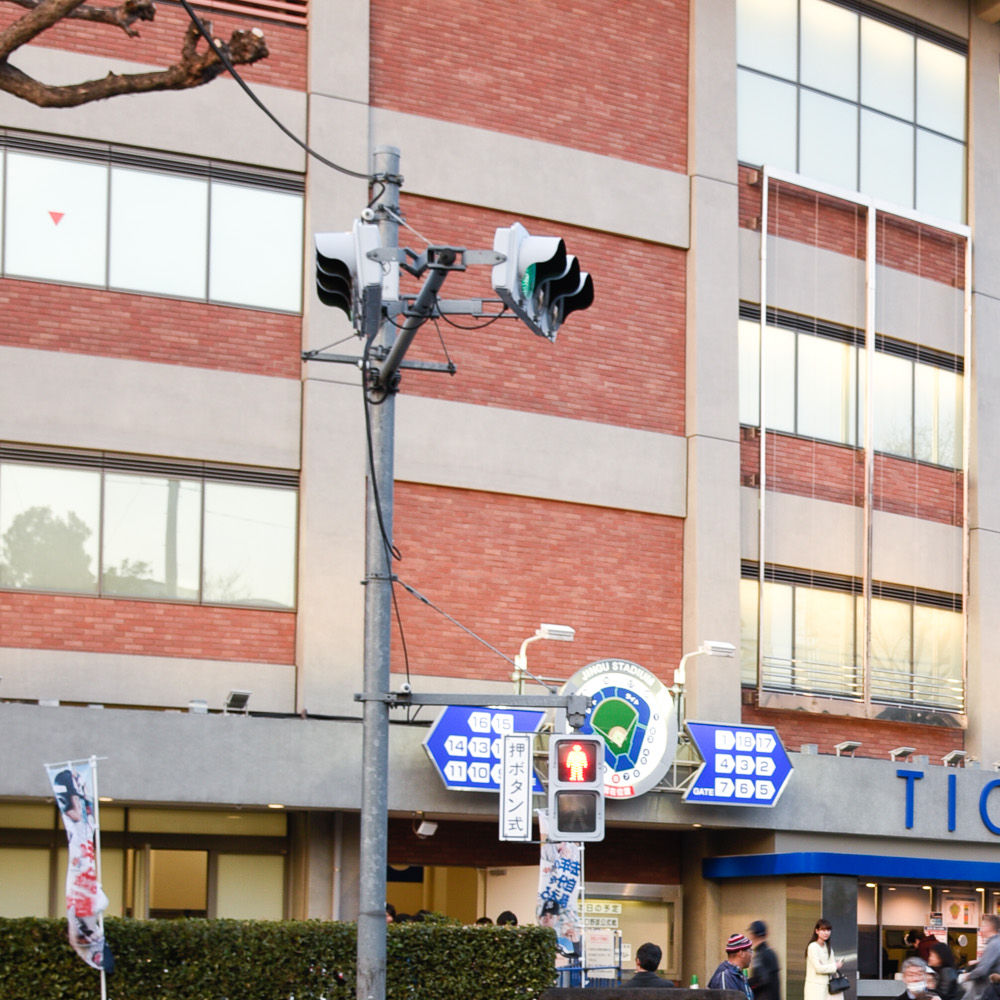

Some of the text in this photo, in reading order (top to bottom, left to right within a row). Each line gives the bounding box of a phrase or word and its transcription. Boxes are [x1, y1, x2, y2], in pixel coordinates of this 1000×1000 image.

[581, 661, 656, 687] JINGU STADIUM
[472, 716, 511, 730] 16 15
[448, 739, 465, 751] 14
[472, 741, 488, 754] 13
[738, 735, 752, 747] 18
[758, 737, 772, 749] 17
[448, 764, 463, 778] 11
[472, 766, 488, 779] 10
[720, 758, 769, 772] 4 3 2
[508, 742, 525, 832] 押ボタン式
[692, 781, 768, 796] GATE 7 6 5
